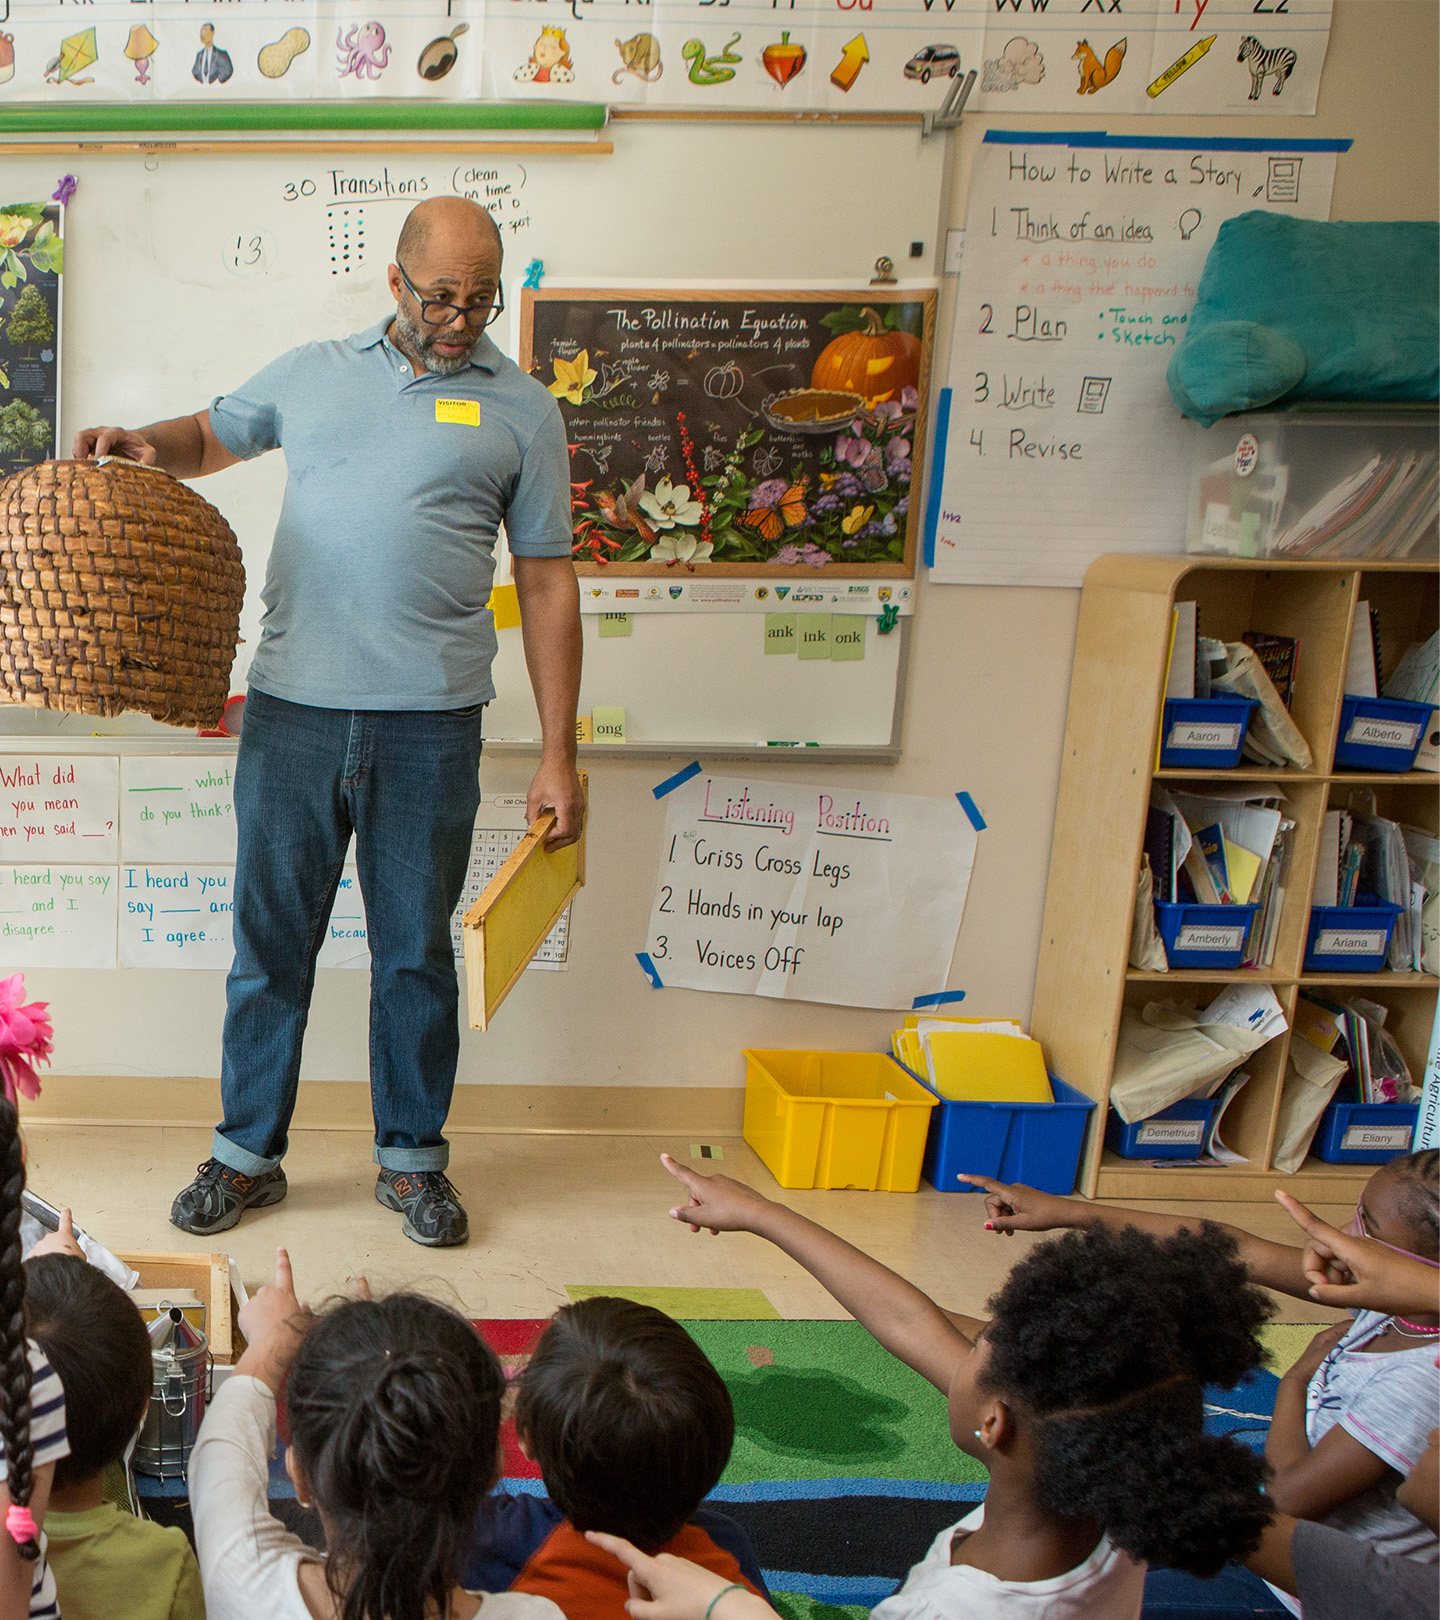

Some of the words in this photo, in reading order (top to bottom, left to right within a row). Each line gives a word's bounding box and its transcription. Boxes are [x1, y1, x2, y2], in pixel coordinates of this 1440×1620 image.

[1009, 150, 1056, 182] How
[1067, 152, 1091, 183] to
[1104, 153, 1153, 184] Write
[1164, 169, 1178, 184] a
[1189, 154, 1242, 195] Story
[283, 178, 316, 201] 30
[326, 166, 429, 197] Transitions
[485, 183, 513, 196] time
[509, 216, 532, 234] spot
[1010, 207, 1060, 239] Think
[1069, 210, 1092, 239] of
[1094, 223, 1114, 239] an
[1121, 215, 1155, 241] idea
[1059, 249, 1097, 275] thing
[1102, 256, 1131, 277] you
[1137, 251, 1157, 270] do
[606, 309, 639, 331] The
[641, 308, 730, 331] Pollination
[740, 309, 809, 339] Equation
[1014, 305, 1067, 338] Plan
[1110, 308, 1155, 324] Touch
[1163, 312, 1188, 325] and
[620, 338, 650, 353] plants
[784, 337, 810, 352] plants
[1112, 328, 1176, 346] Sketch
[1002, 373, 1056, 406] Write
[1009, 428, 1083, 460] Revise
[768, 625, 794, 639] ank
[803, 629, 826, 643] ink
[835, 630, 861, 645] onk
[596, 723, 623, 738] ong
[1187, 730, 1221, 743] Aaron
[1362, 726, 1402, 741] Alberto
[52, 764, 75, 785] did
[195, 769, 232, 789] what
[11, 800, 35, 818] you
[45, 798, 79, 811] mean
[502, 798, 514, 806] 100
[703, 779, 795, 836] Listening
[818, 795, 891, 834] Position
[140, 805, 155, 820] do
[162, 810, 182, 825] you
[189, 802, 232, 819] think?
[24, 826, 45, 842] you
[54, 821, 75, 836] said
[694, 839, 743, 870] Criss
[755, 845, 802, 876] Cross
[813, 850, 851, 888] Legs
[13, 868, 51, 885] heard
[60, 873, 83, 891] you
[87, 875, 111, 894] say
[124, 869, 138, 888] I
[146, 868, 189, 888] heard
[197, 875, 227, 895] you
[31, 897, 55, 912] and
[66, 898, 79, 911] I
[128, 900, 154, 921] say
[687, 888, 741, 920] Hands
[747, 904, 763, 922] in
[770, 909, 809, 931] your
[817, 906, 844, 937] lap
[142, 928, 155, 942] I
[1187, 933, 1231, 946] Amberly
[1332, 937, 1368, 948] Ariana
[696, 939, 756, 971] Voices
[764, 946, 805, 975] Off
[1420, 1073, 1440, 1152] Agricultur
[1146, 1127, 1197, 1139] Demetrius
[1362, 1132, 1394, 1145] Eliany
